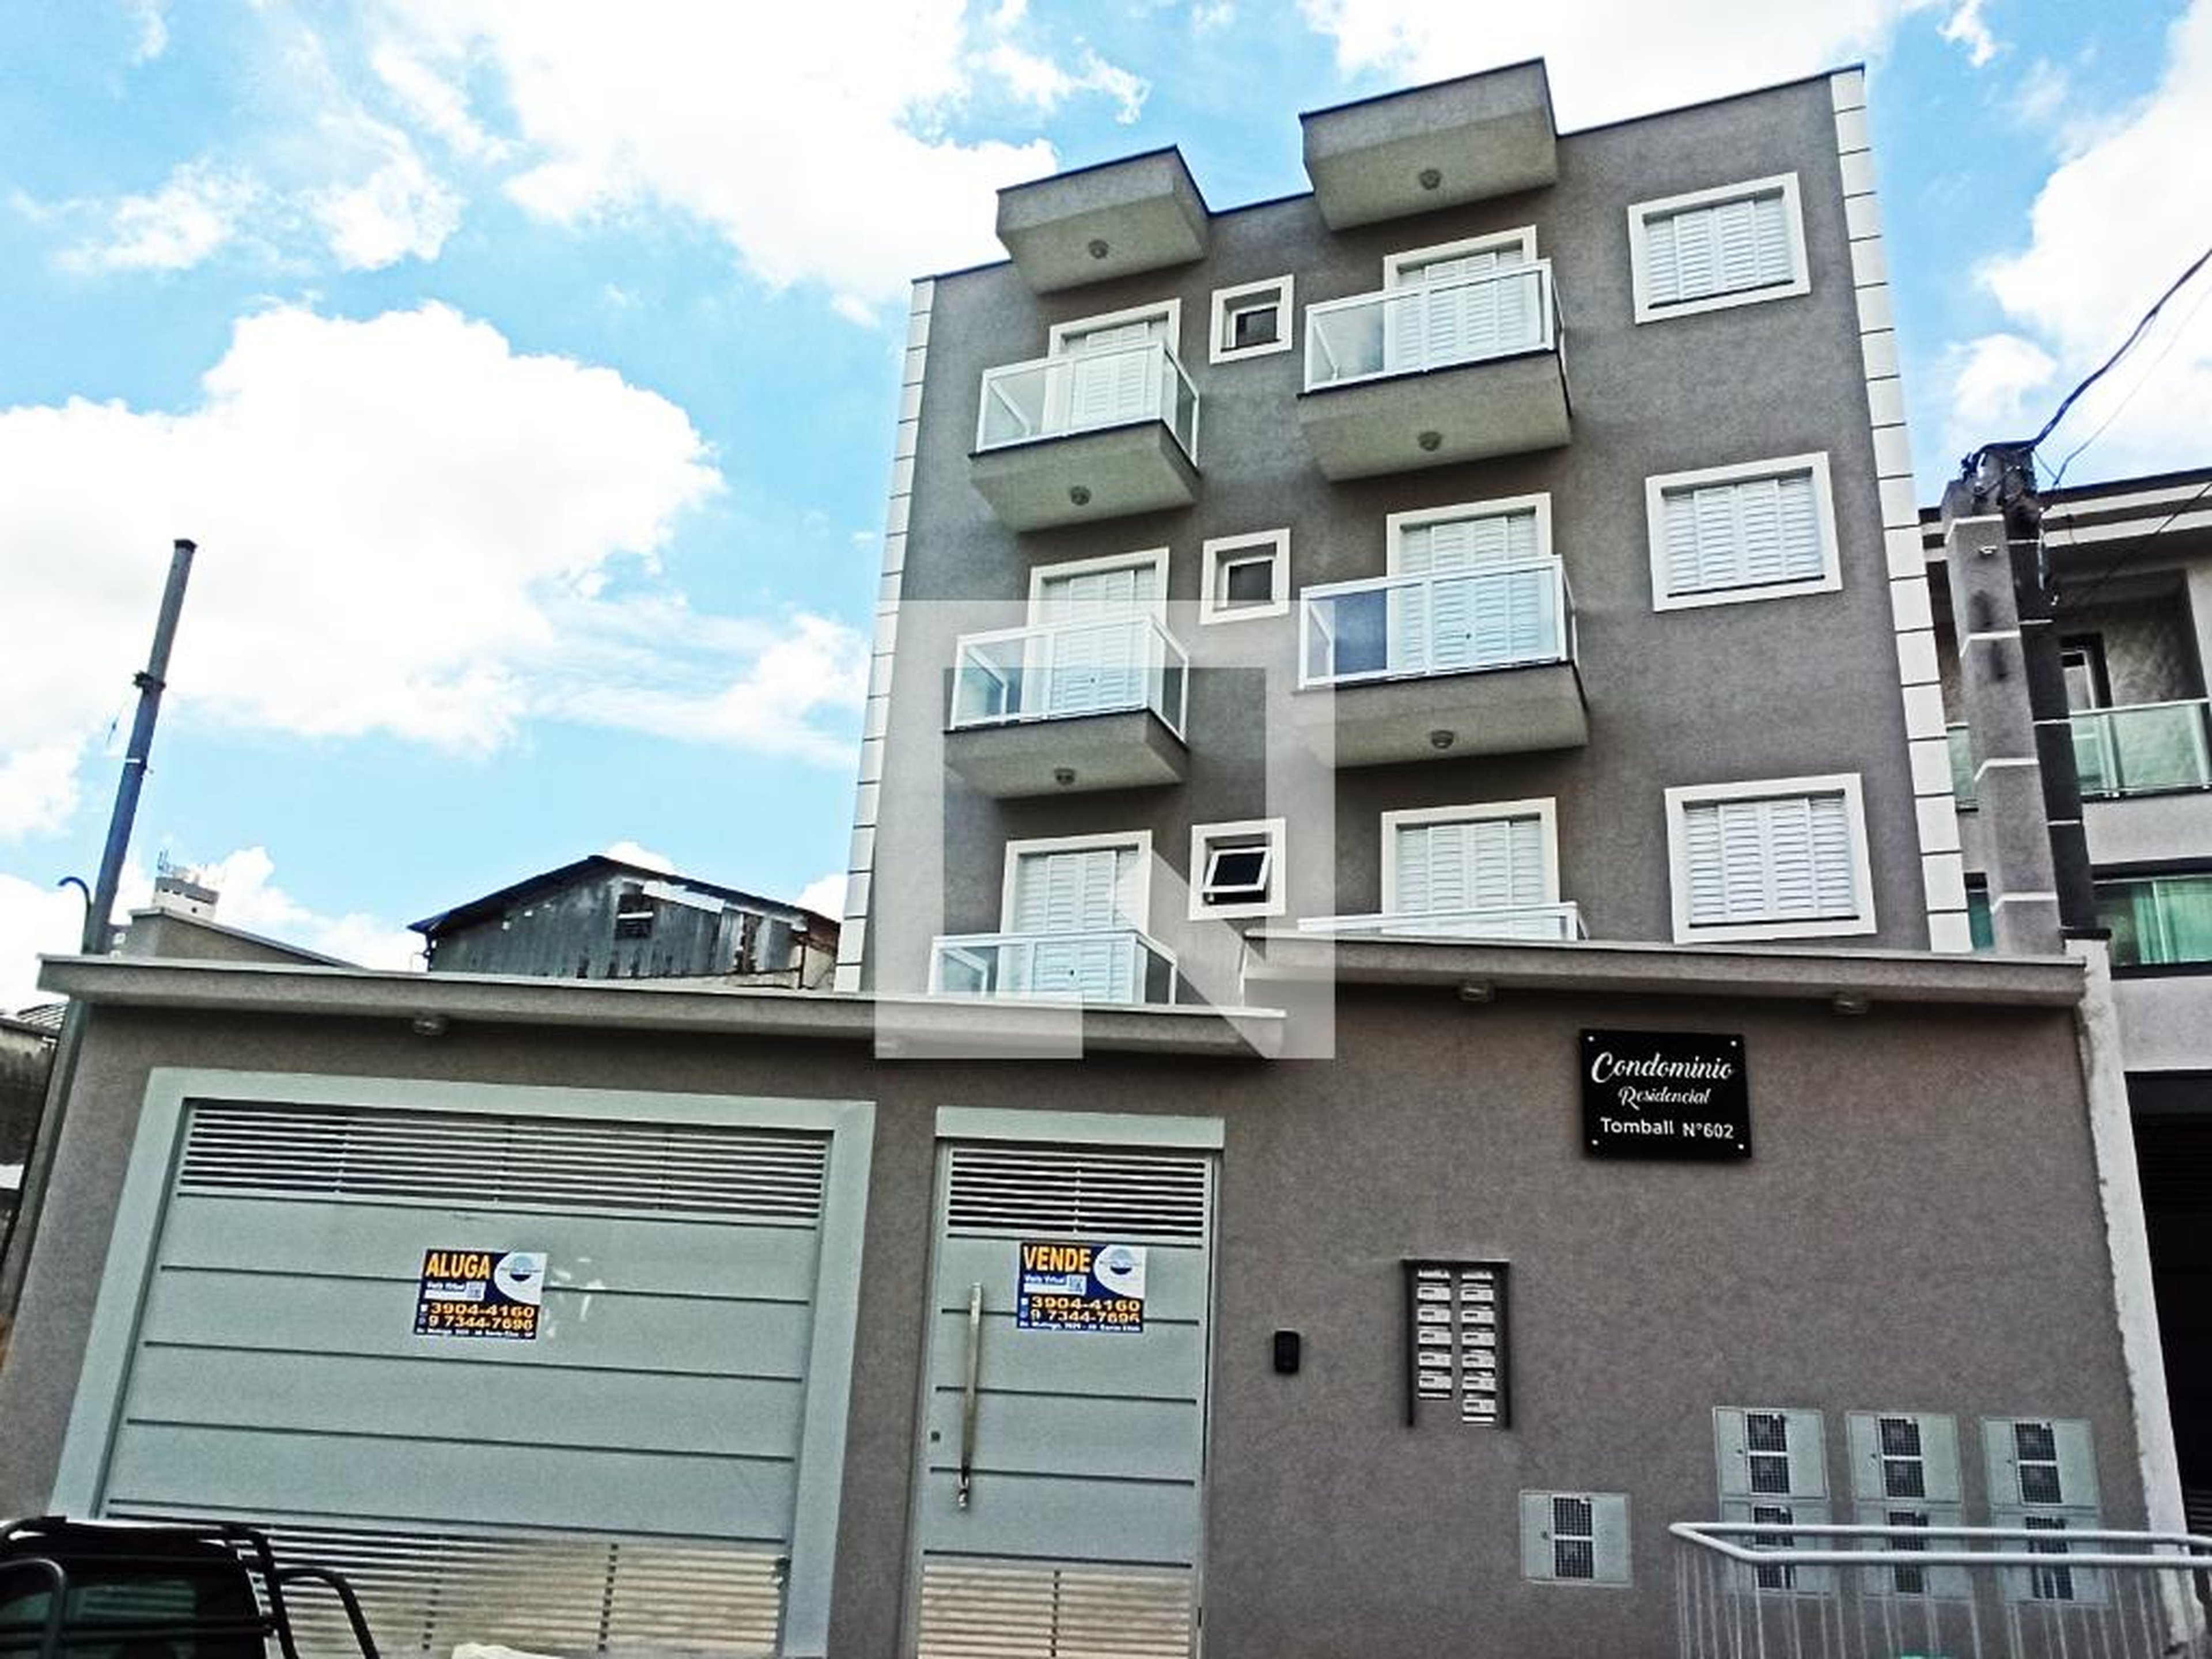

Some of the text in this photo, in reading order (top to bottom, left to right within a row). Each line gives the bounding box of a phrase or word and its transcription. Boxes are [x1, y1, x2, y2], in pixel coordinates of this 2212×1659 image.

[1618, 1086, 1711, 1111] Residencial
[1600, 1116, 1674, 1135] Tomball
[425, 1252, 490, 1279] ALUGA
[1023, 1246, 1091, 1272] VENDE
[430, 1302, 535, 1318] 3904-4160
[1032, 1297, 1140, 1312] 3904-4160
